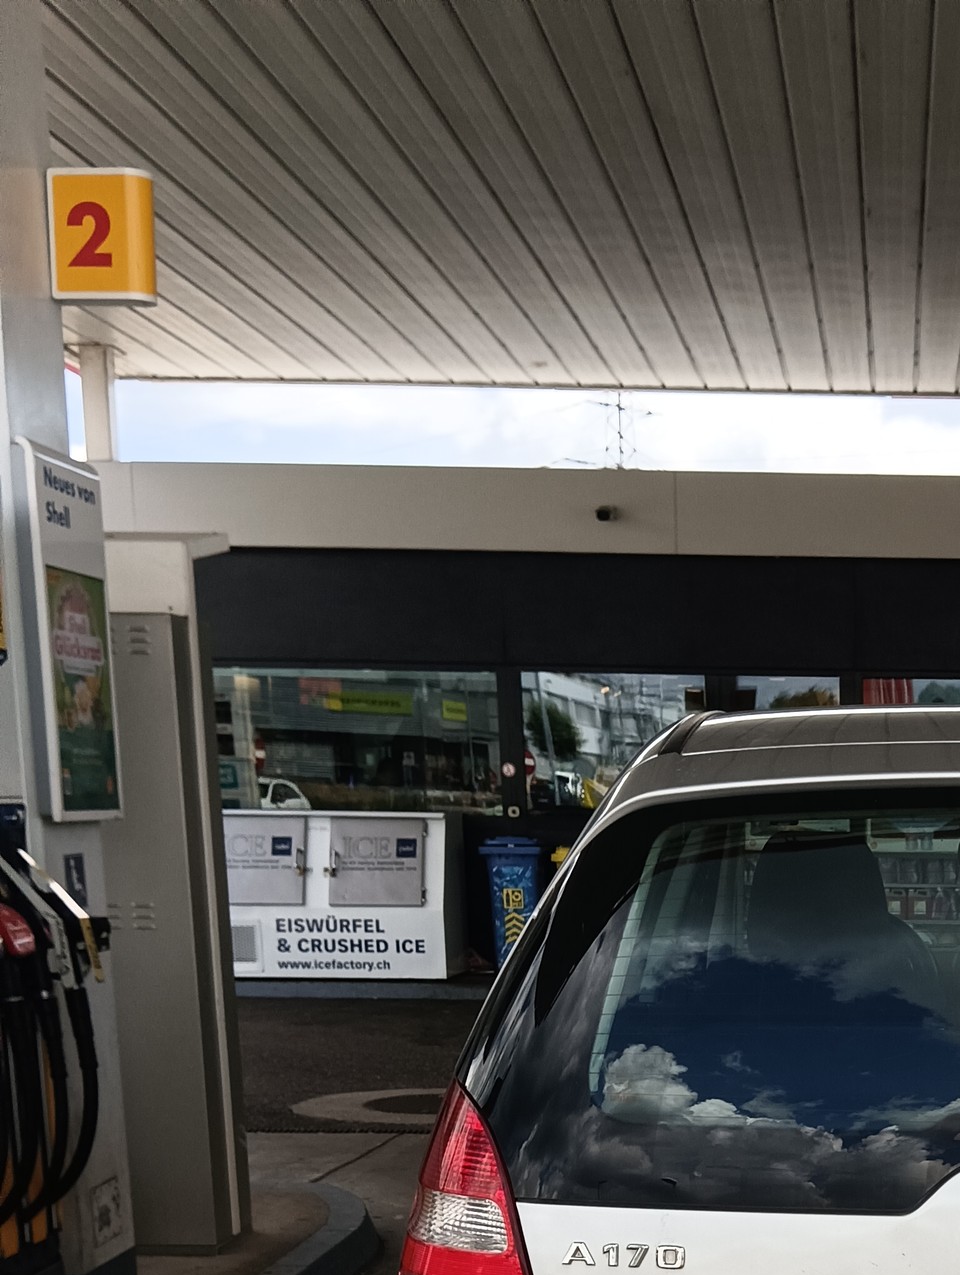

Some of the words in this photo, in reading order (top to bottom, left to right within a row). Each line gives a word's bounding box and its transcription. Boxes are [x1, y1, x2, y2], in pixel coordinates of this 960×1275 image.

[66, 201, 112, 268] 2
[43, 465, 75, 498] Neues
[77, 485, 96, 505] von
[46, 501, 71, 529] Shell
[275, 915, 385, 933] EISWÜRFEL
[277, 938, 291, 953] &
[297, 938, 389, 953] CRUSHED
[395, 939, 426, 954] ICE
[278, 959, 391, 973] www.icefactory.ch
